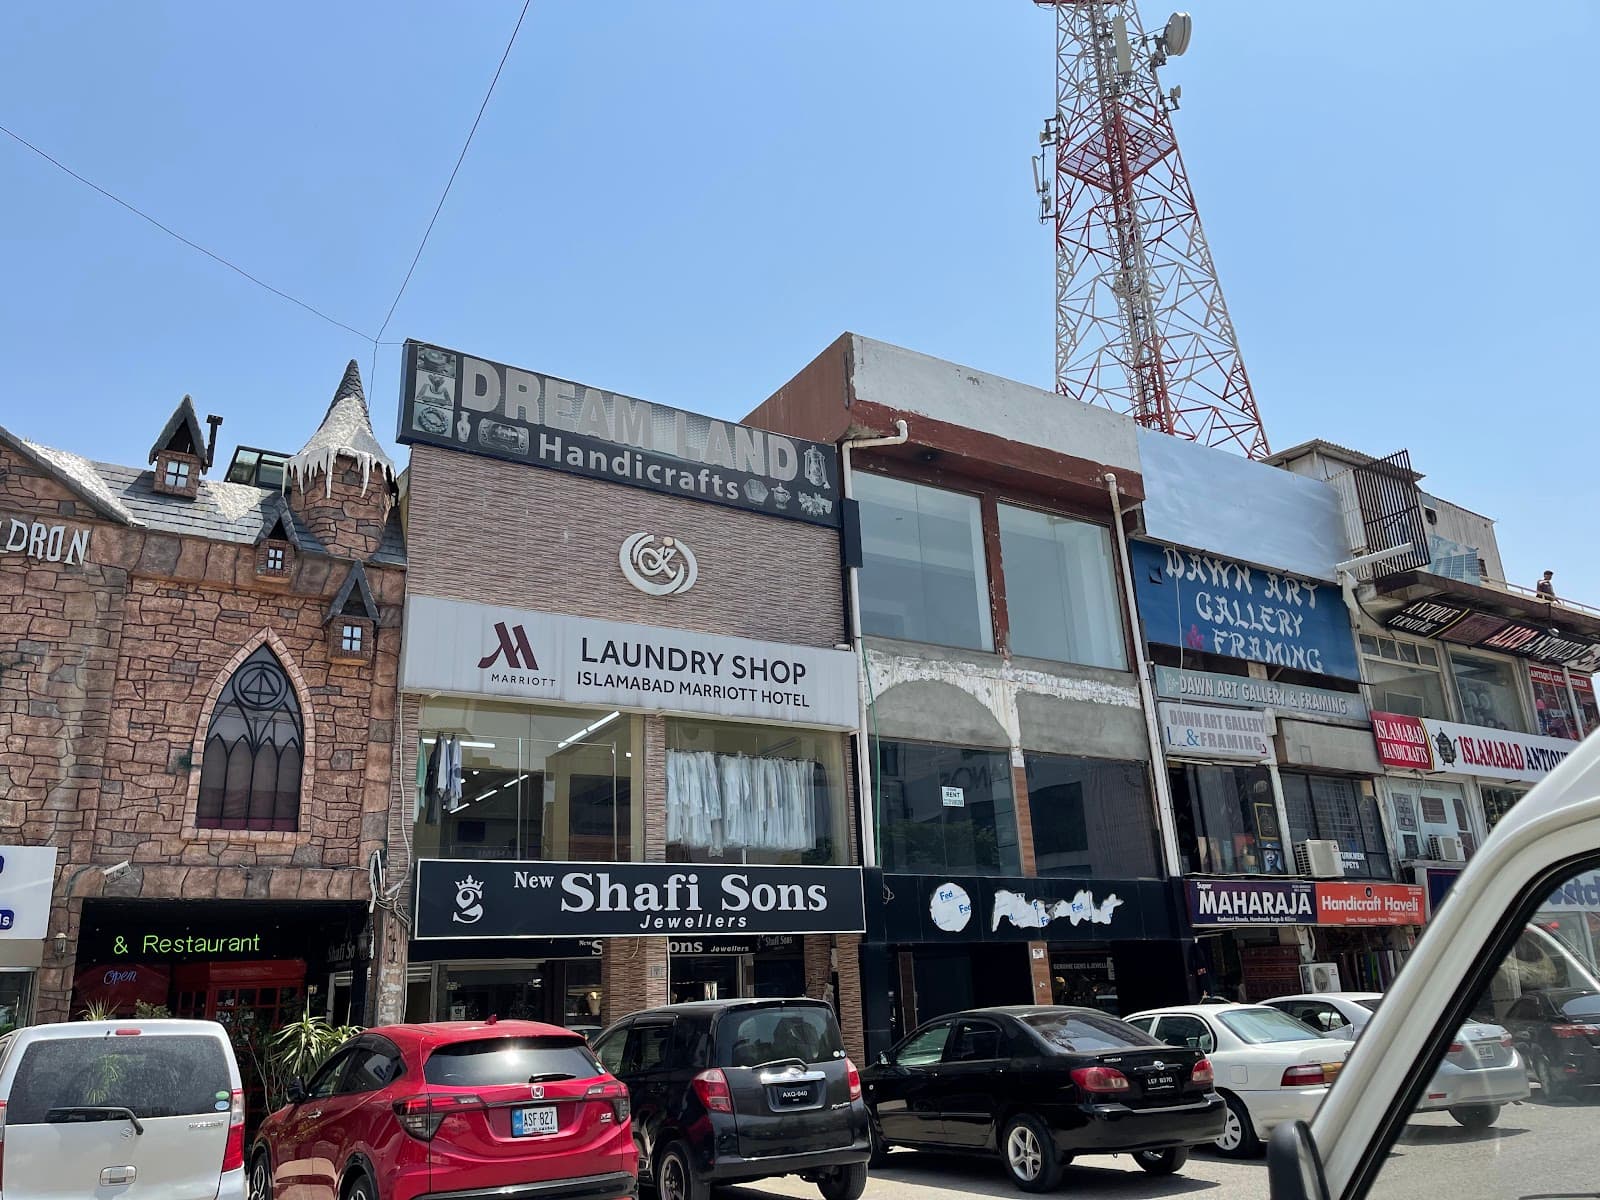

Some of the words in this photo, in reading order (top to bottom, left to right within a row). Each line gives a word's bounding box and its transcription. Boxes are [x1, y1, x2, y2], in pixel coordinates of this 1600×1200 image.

[461, 357, 653, 450] DREAM
[675, 411, 798, 481] LAND
[539, 433, 739, 500] Handicrafts
[1163, 548, 1253, 595] DAWN
[1264, 573, 1318, 609] ART
[1196, 591, 1303, 638] GALLERY
[581, 637, 724, 676] LAUNDRY
[731, 655, 806, 685] SHOP
[1211, 628, 1325, 674] FRAMING
[491, 673, 556, 687] MARRIOTT
[577, 671, 674, 693] ISLAMABAD
[679, 681, 757, 702] MARRIOTT
[761, 690, 810, 708] HOTEL
[1180, 675, 1214, 697] DAWN
[1217, 679, 1239, 699] ART
[1241, 683, 1286, 707] GALLERY
[1289, 690, 1299, 708] &
[1299, 692, 1348, 715] FRAMING
[1169, 709, 1202, 727] DAWN
[1203, 712, 1223, 729] ART
[1224, 715, 1265, 733] GALLERY
[1374, 719, 1425, 744] ISLAMABAD
[1186, 728, 1200, 747] &
[1200, 731, 1262, 751] FRAMING
[1381, 741, 1429, 764] HANDICRAFTS
[1458, 736, 1525, 770] ISLAMABAD
[1525, 745, 1569, 772] ANTIQU
[513, 871, 554, 889] New
[560, 873, 702, 913] Shafi
[721, 873, 828, 913] Sons
[1199, 890, 1313, 915] MAHARAJA
[1321, 895, 1381, 911] Handicraft
[1384, 896, 1419, 912] Haveli
[639, 913, 747, 930] Jewellers
[113, 935, 129, 955] &
[143, 933, 261, 954] Restaurant
[669, 940, 703, 953] ons
[710, 944, 750, 953] Jewellers
[103, 970, 138, 985] Open
[524, 1112, 537, 1127] ASF
[540, 1111, 553, 1125] 827
